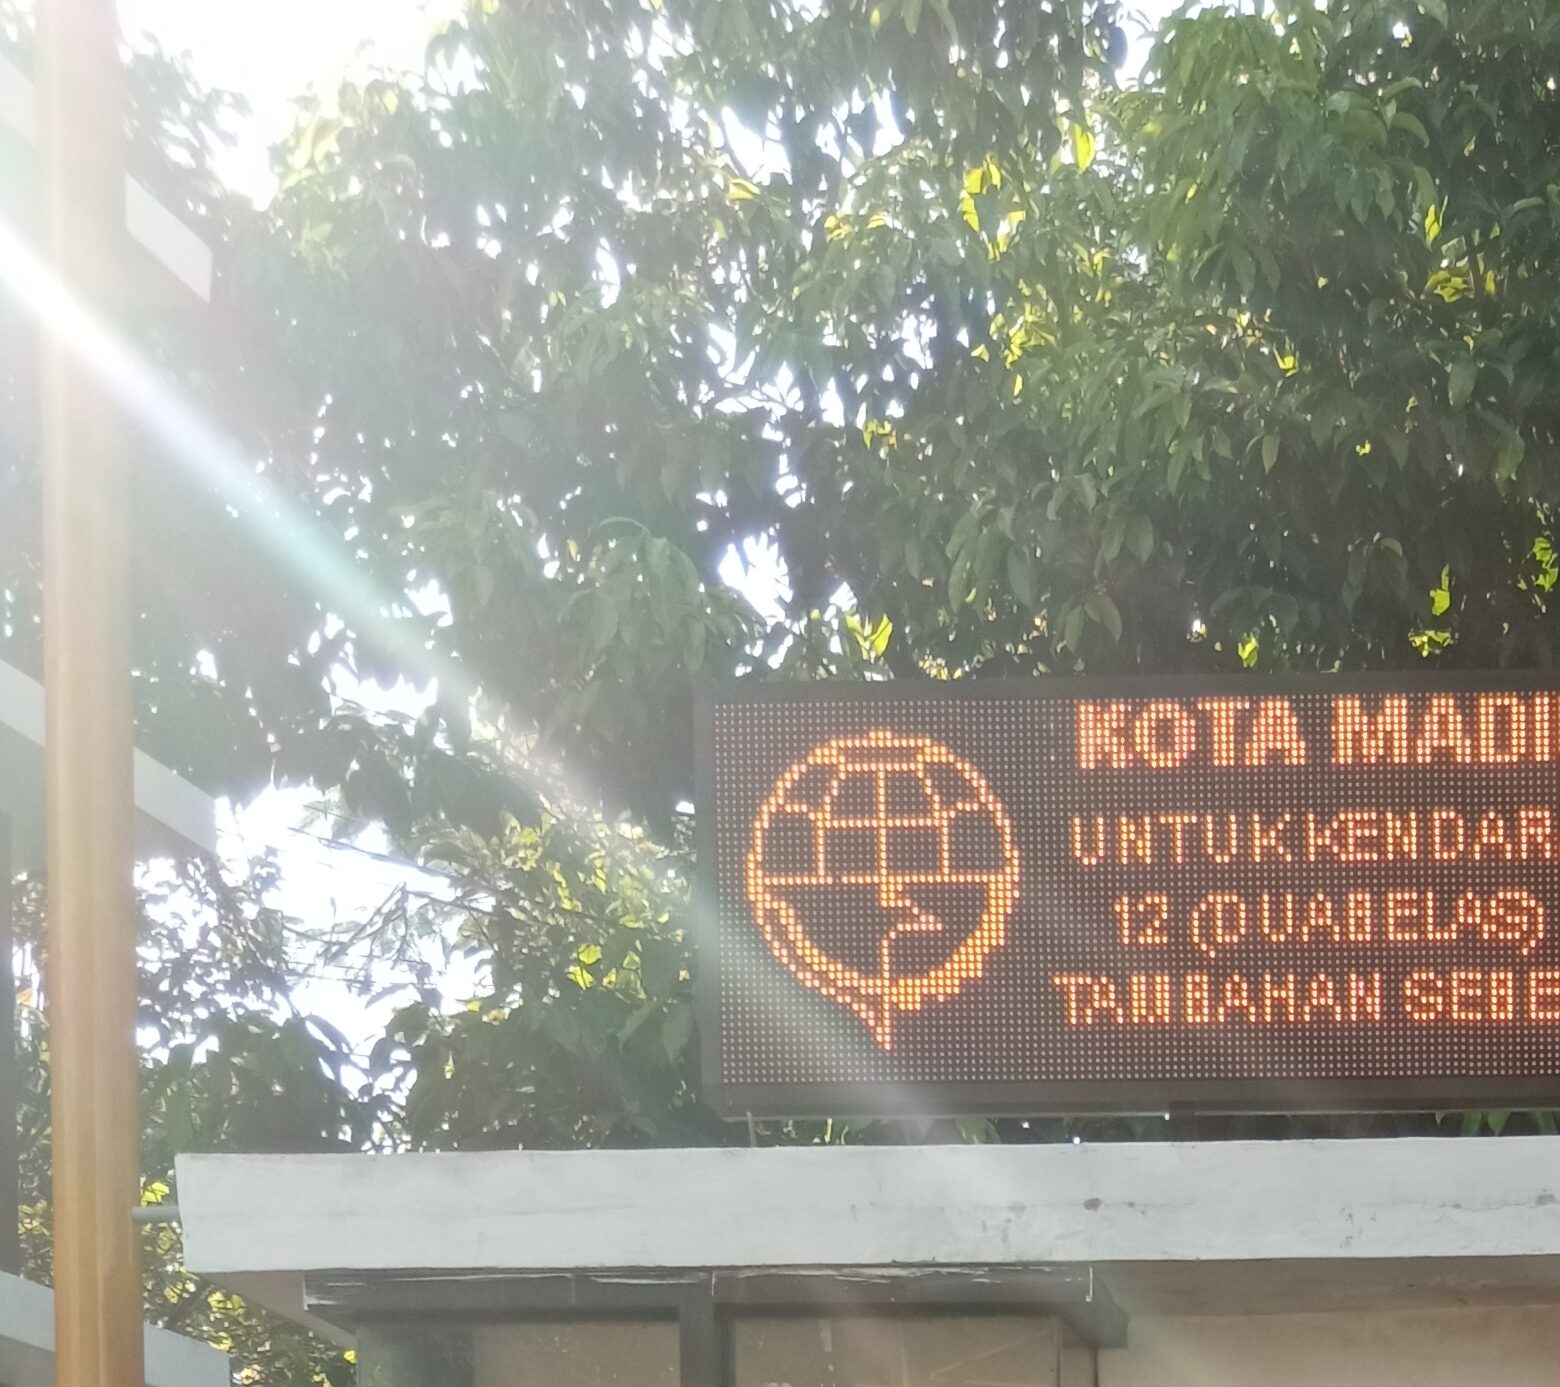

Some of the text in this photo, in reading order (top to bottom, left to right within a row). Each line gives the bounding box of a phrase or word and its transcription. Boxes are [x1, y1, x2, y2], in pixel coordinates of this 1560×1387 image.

[1074, 699, 1306, 769] KOTA
[1070, 813, 1293, 865] UNTUK
[1114, 894, 1169, 945] 12
[1189, 888, 1546, 959] (DUABELAS)
[1052, 972, 1382, 1025] TAMBAHAN
